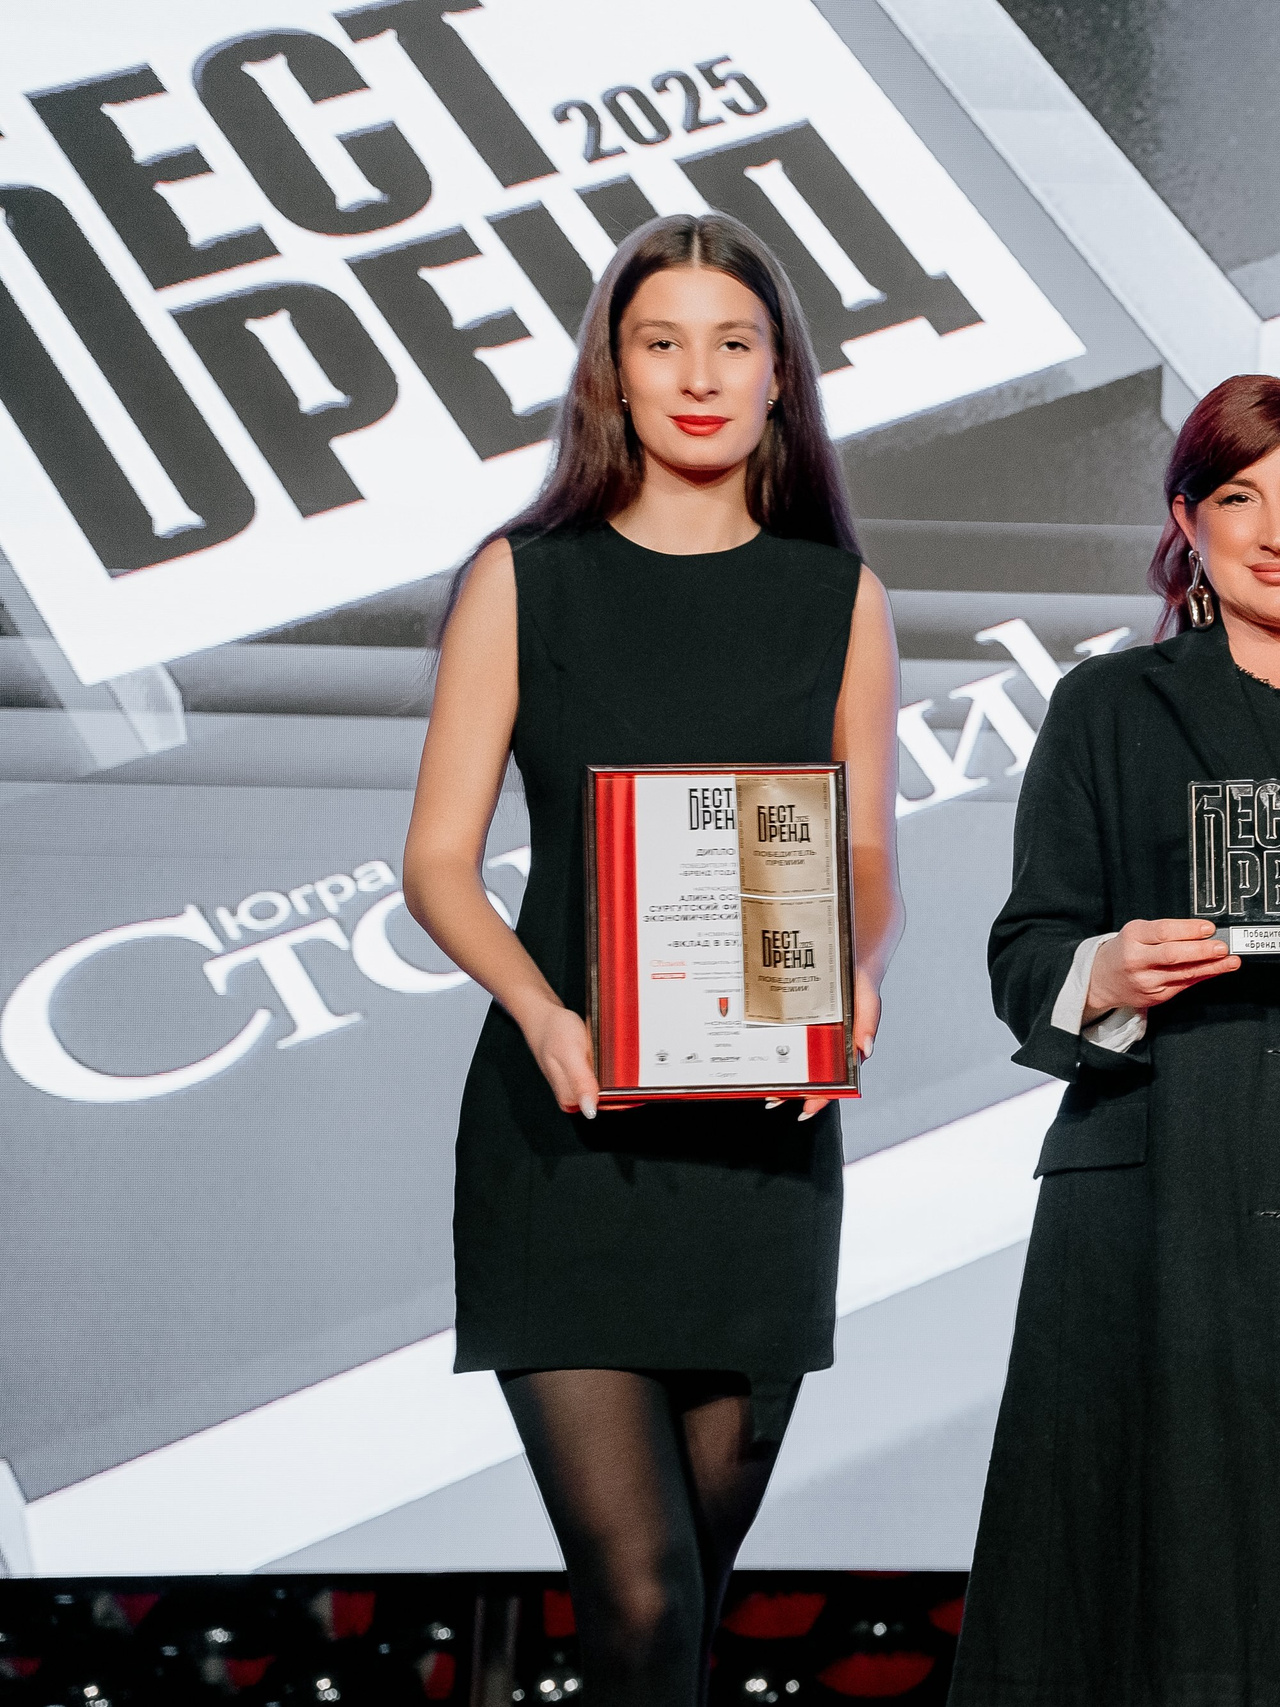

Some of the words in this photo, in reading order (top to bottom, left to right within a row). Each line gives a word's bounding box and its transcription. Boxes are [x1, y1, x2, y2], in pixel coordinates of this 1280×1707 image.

[552, 54, 767, 163] 2025
[696, 848, 737, 857] ДИПЛО
[753, 849, 817, 858] ПОБЕДИТЕЛЬ
[764, 859, 805, 867] ПРЕМИИ
[649, 903, 719, 913] СУРГУТСКИЙ
[642, 912, 740, 923] ЭКОНОМИЧЕСКИЙ
[1244, 939, 1277, 950] «Бренд
[757, 975, 821, 984] ПОБЕДИТЕЛЬ
[770, 985, 809, 993] ПРЕМИИ
